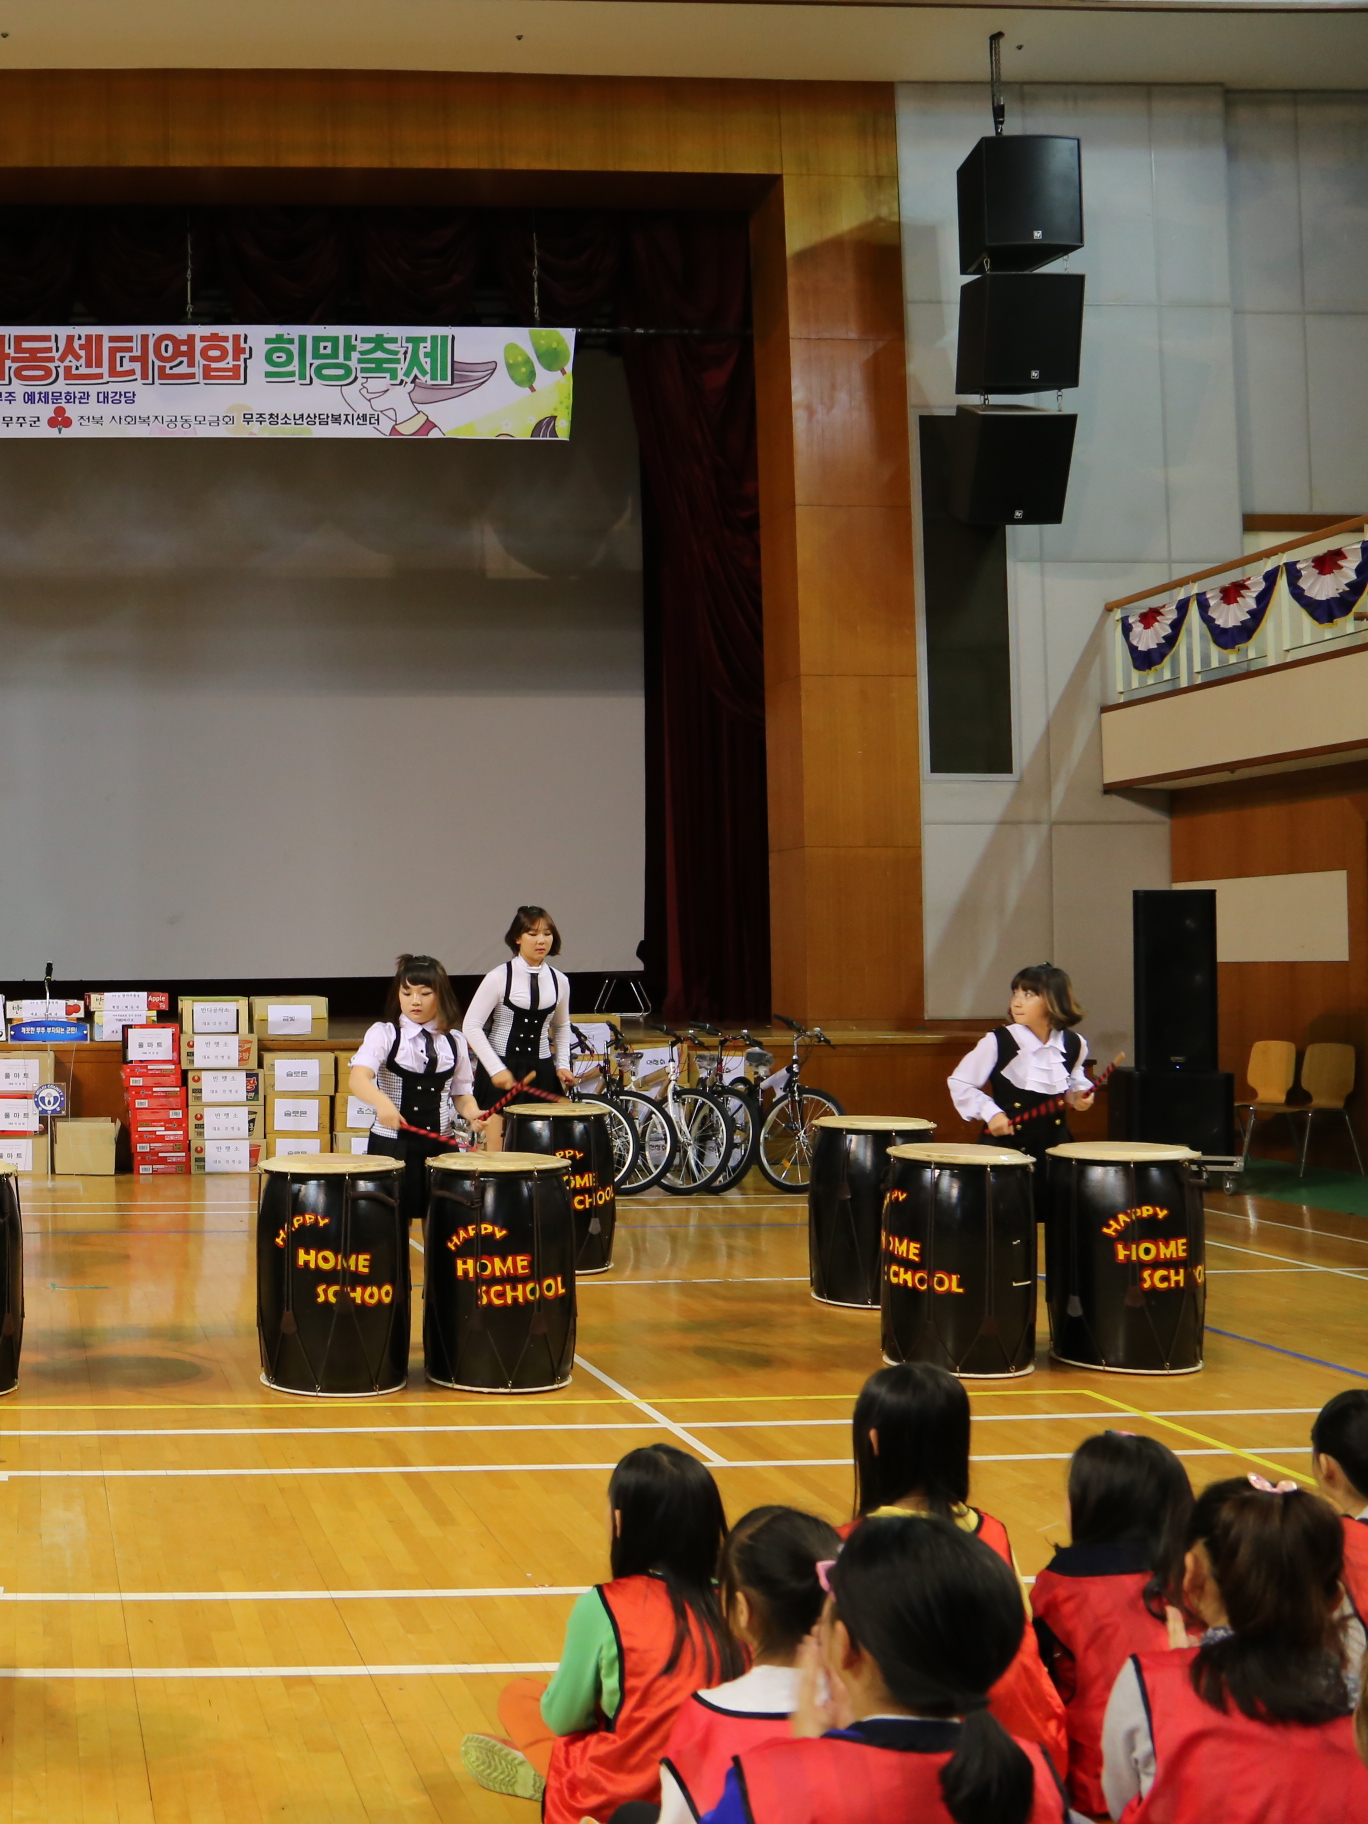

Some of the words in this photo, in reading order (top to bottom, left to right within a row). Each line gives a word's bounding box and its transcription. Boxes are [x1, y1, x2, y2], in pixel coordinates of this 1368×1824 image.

[263, 333, 451, 384] 희망축제
[23, 391, 91, 405] 예체문화관
[96, 391, 137, 405] 대강당
[1, 415, 41, 428] 무주군
[77, 415, 105, 427] 전북
[109, 414, 235, 429] 사회복지공동모금회
[241, 412, 380, 426] 무주청소년상담복지센터
[563, 1171, 598, 1190] OME
[573, 1185, 614, 1210] CHOOL
[1101, 1204, 1169, 1239] HAPPY
[446, 1221, 509, 1251] HAPPY
[297, 1247, 371, 1275] HOME
[1114, 1237, 1188, 1263] HOME
[455, 1254, 531, 1280] HOME
[316, 1283, 393, 1306] SCHOO
[477, 1275, 566, 1307] SCHOOL
